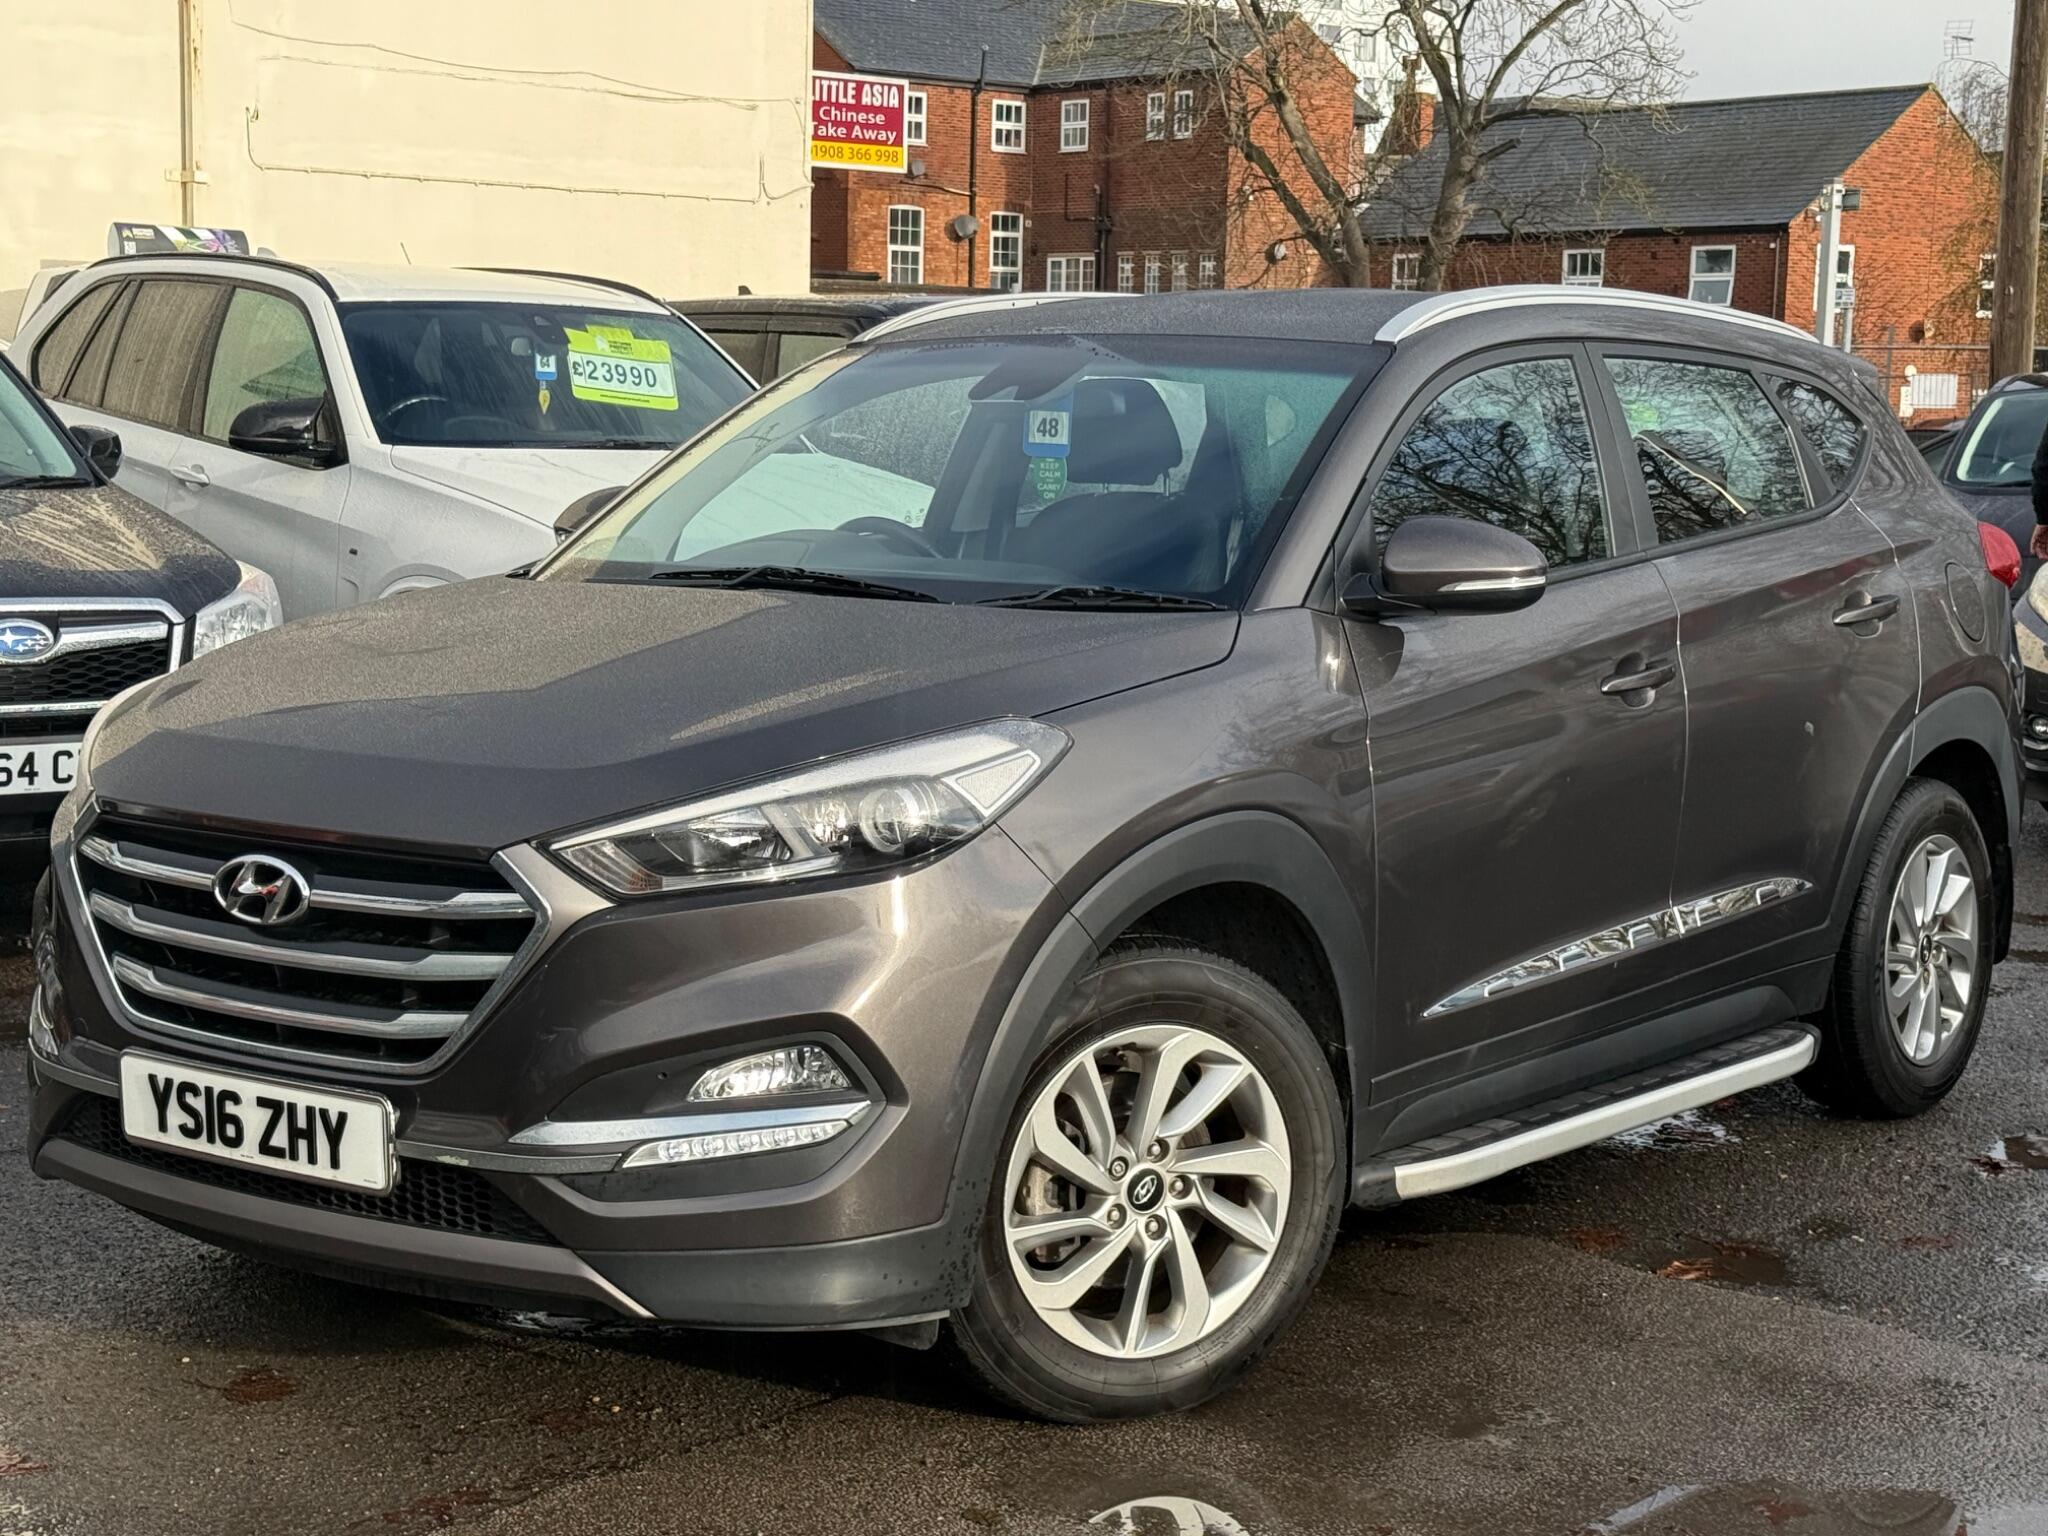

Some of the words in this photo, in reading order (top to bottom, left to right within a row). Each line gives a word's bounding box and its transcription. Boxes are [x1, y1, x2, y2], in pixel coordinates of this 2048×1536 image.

[812, 79, 857, 105] ITTLE
[861, 83, 900, 109] ASIA
[819, 106, 886, 125] Chinese
[811, 121, 847, 138] Take
[851, 125, 897, 145] Away
[811, 144, 844, 160] 1908
[847, 146, 872, 161] 366
[875, 149, 899, 164] 998
[1036, 417, 1059, 438] 48
[1039, 470, 1061, 478] CALM
[1043, 491, 1056, 499] ON
[52, 749, 81, 785] C
[147, 1073, 245, 1150] YS16
[256, 1095, 349, 1171] ZHY
